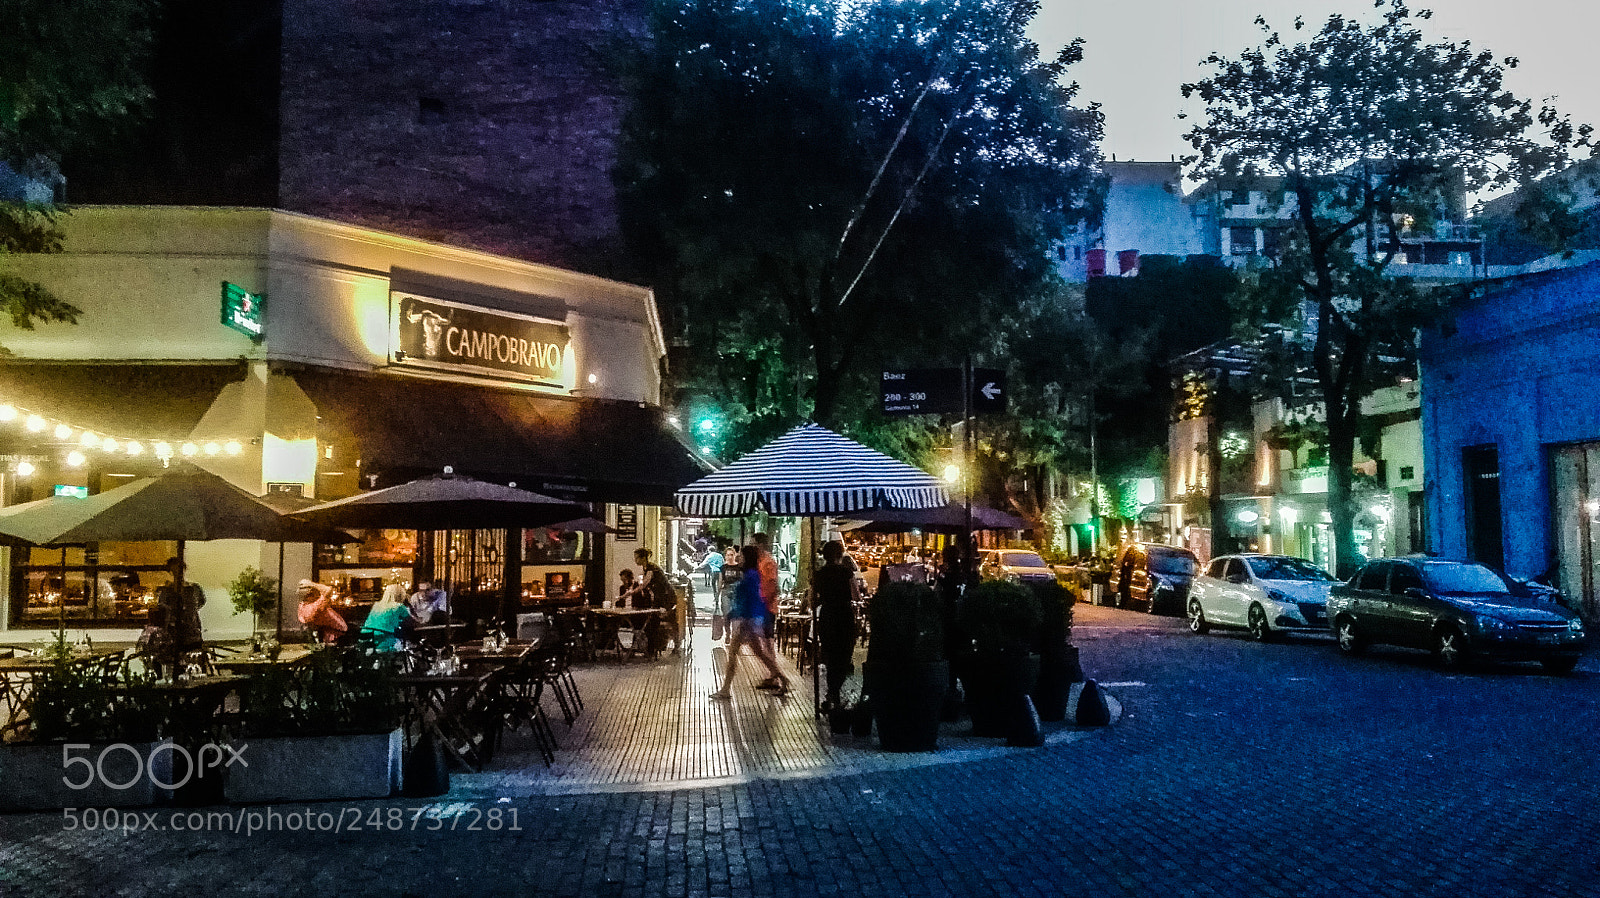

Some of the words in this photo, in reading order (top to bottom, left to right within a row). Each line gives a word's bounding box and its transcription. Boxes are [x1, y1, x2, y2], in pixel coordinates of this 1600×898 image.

[446, 326, 561, 372] CAMPOBRAVO
[884, 393, 901, 402] 200
[909, 392, 926, 401] 300
